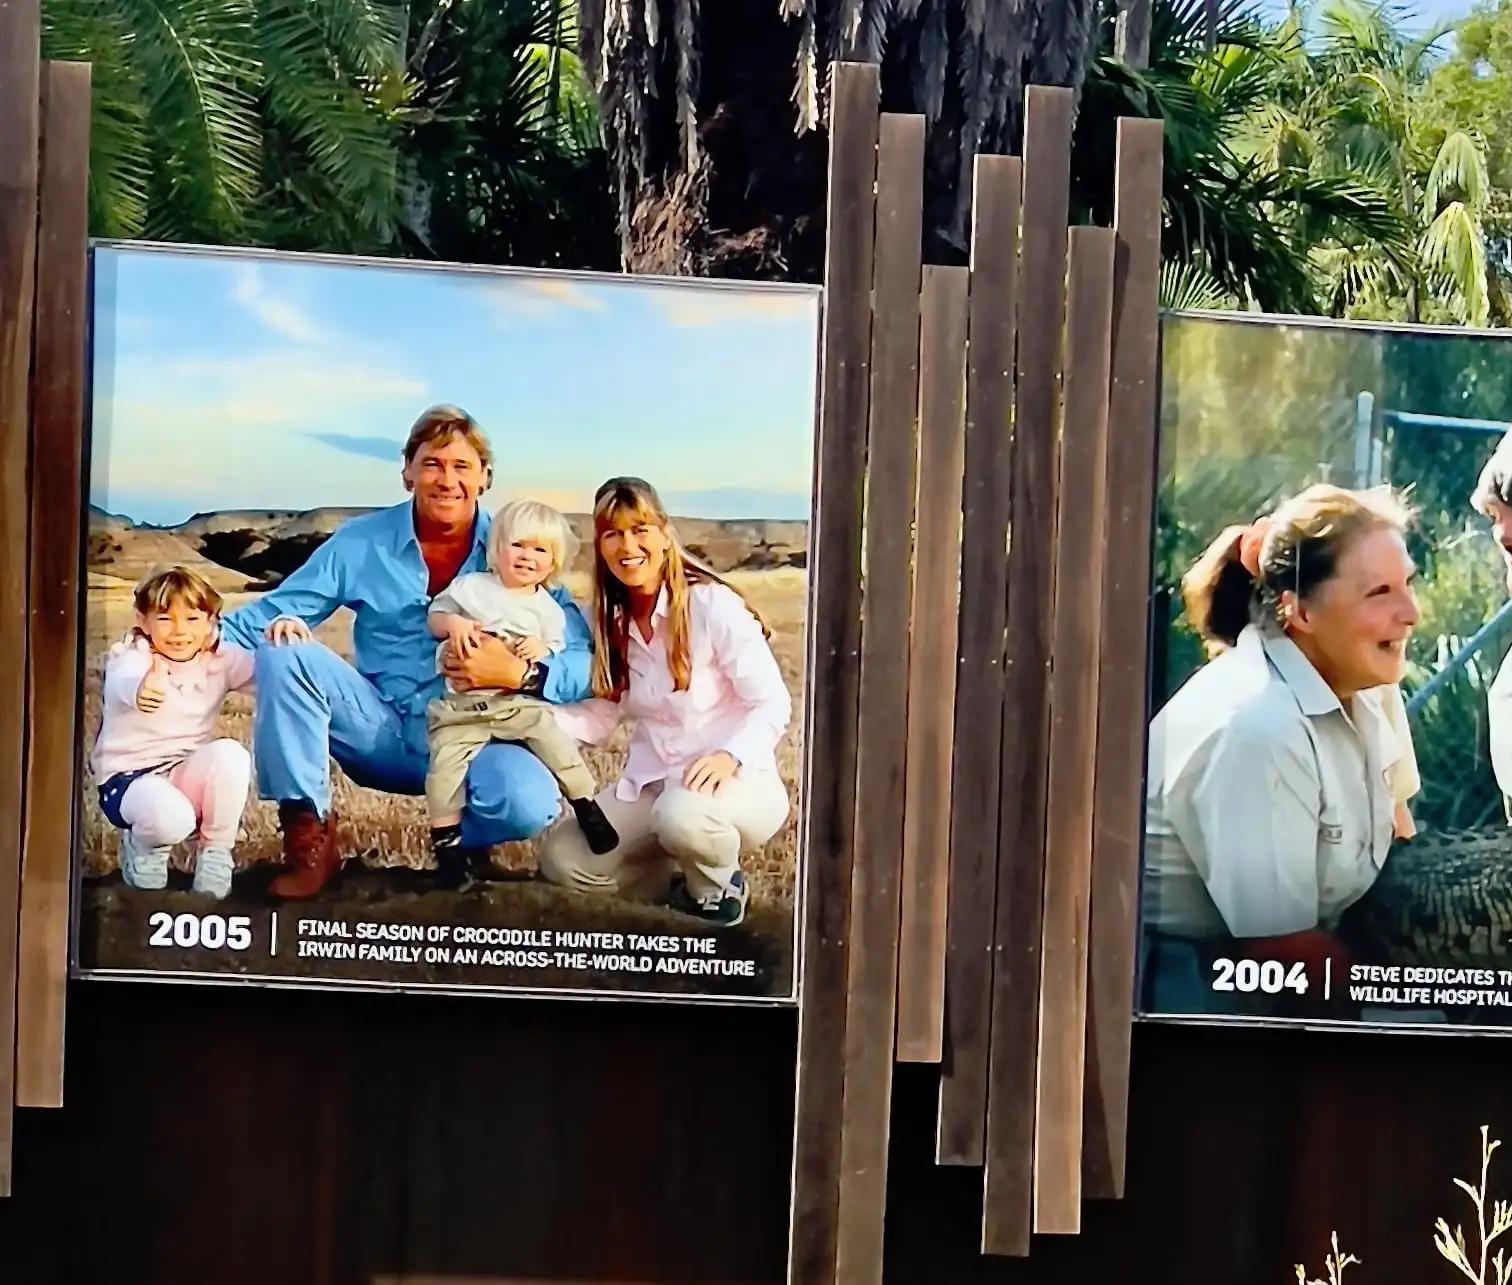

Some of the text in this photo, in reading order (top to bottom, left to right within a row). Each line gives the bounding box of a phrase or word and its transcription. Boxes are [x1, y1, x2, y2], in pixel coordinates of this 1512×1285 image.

[149, 912, 251, 950] 2005
[298, 919, 716, 954] FINAL SEASON OF CROCODILE HUNTER TAKES THE
[298, 940, 755, 976] IRWIN FAMILY ON AN ACROSS-THE-WORLD ADVENTURE
[1350, 965, 1400, 983] STEVE
[1403, 967, 1495, 986] DEDICATES
[1212, 958, 1309, 995] 2004
[1349, 986, 1430, 1004] WILDLIFE
[1434, 988, 1512, 1007] HOSPITAL
